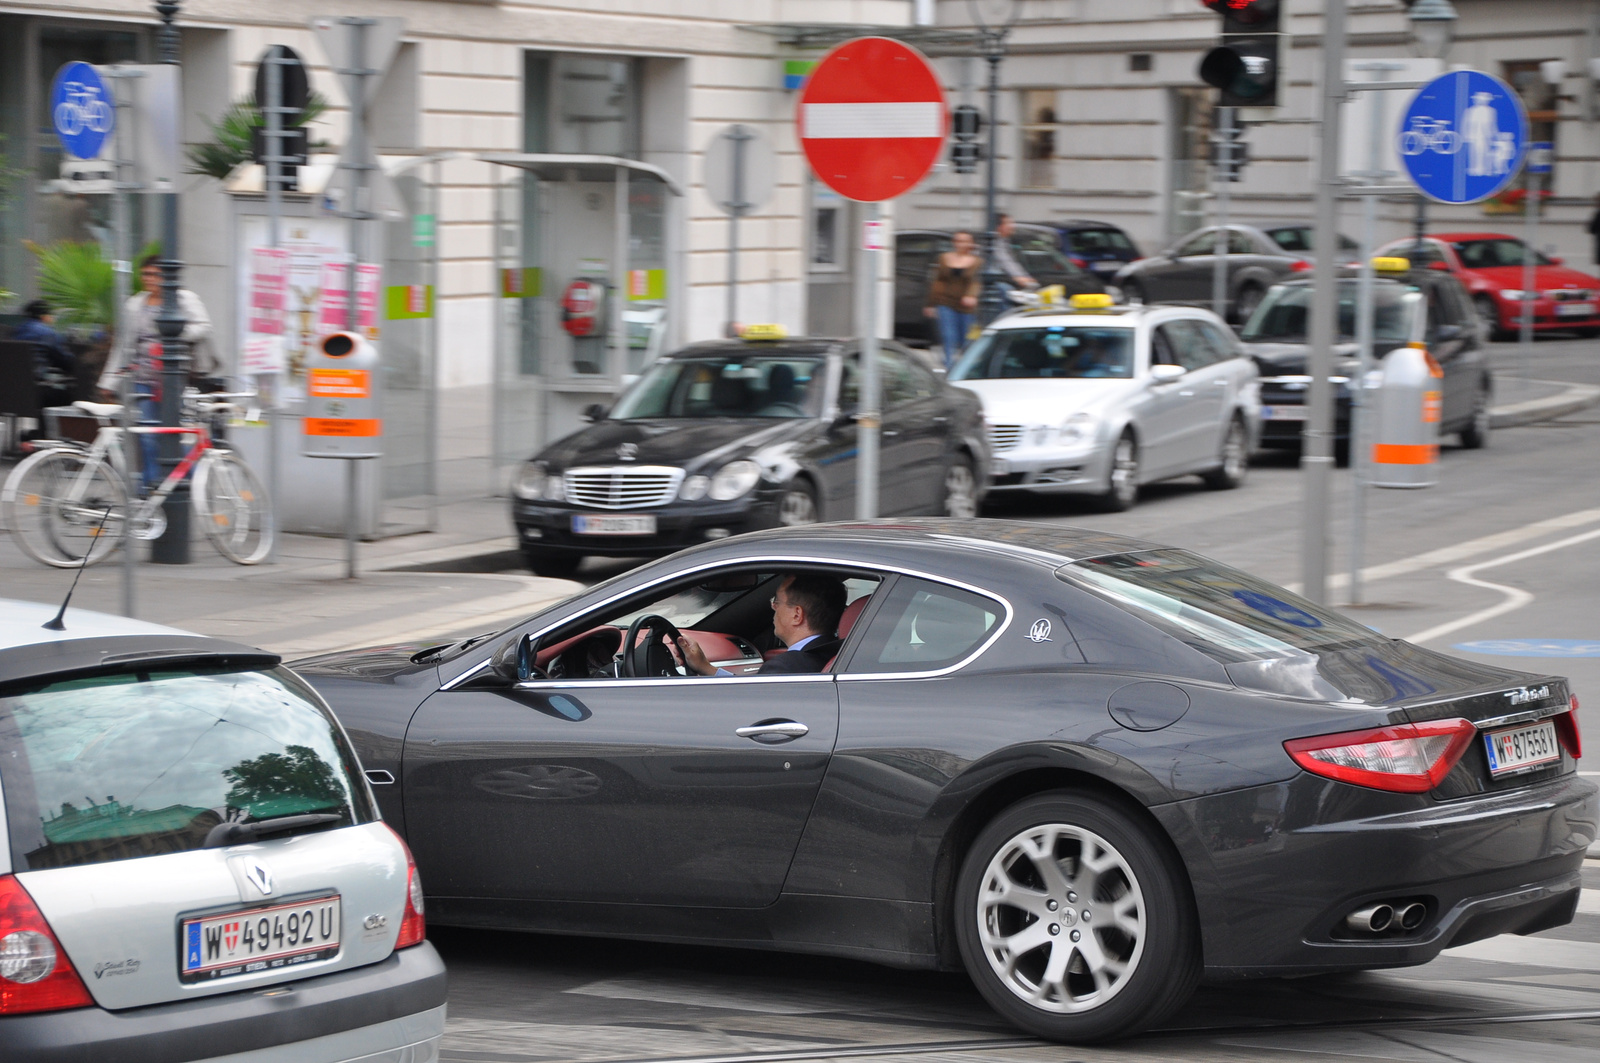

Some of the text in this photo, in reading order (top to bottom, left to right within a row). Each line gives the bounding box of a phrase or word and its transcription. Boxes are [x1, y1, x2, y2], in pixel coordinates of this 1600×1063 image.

[1495, 736, 1507, 764] W
[1512, 728, 1548, 760] 87558
[205, 924, 222, 960] W
[243, 909, 314, 953] 49492
[190, 951, 198, 963] A
